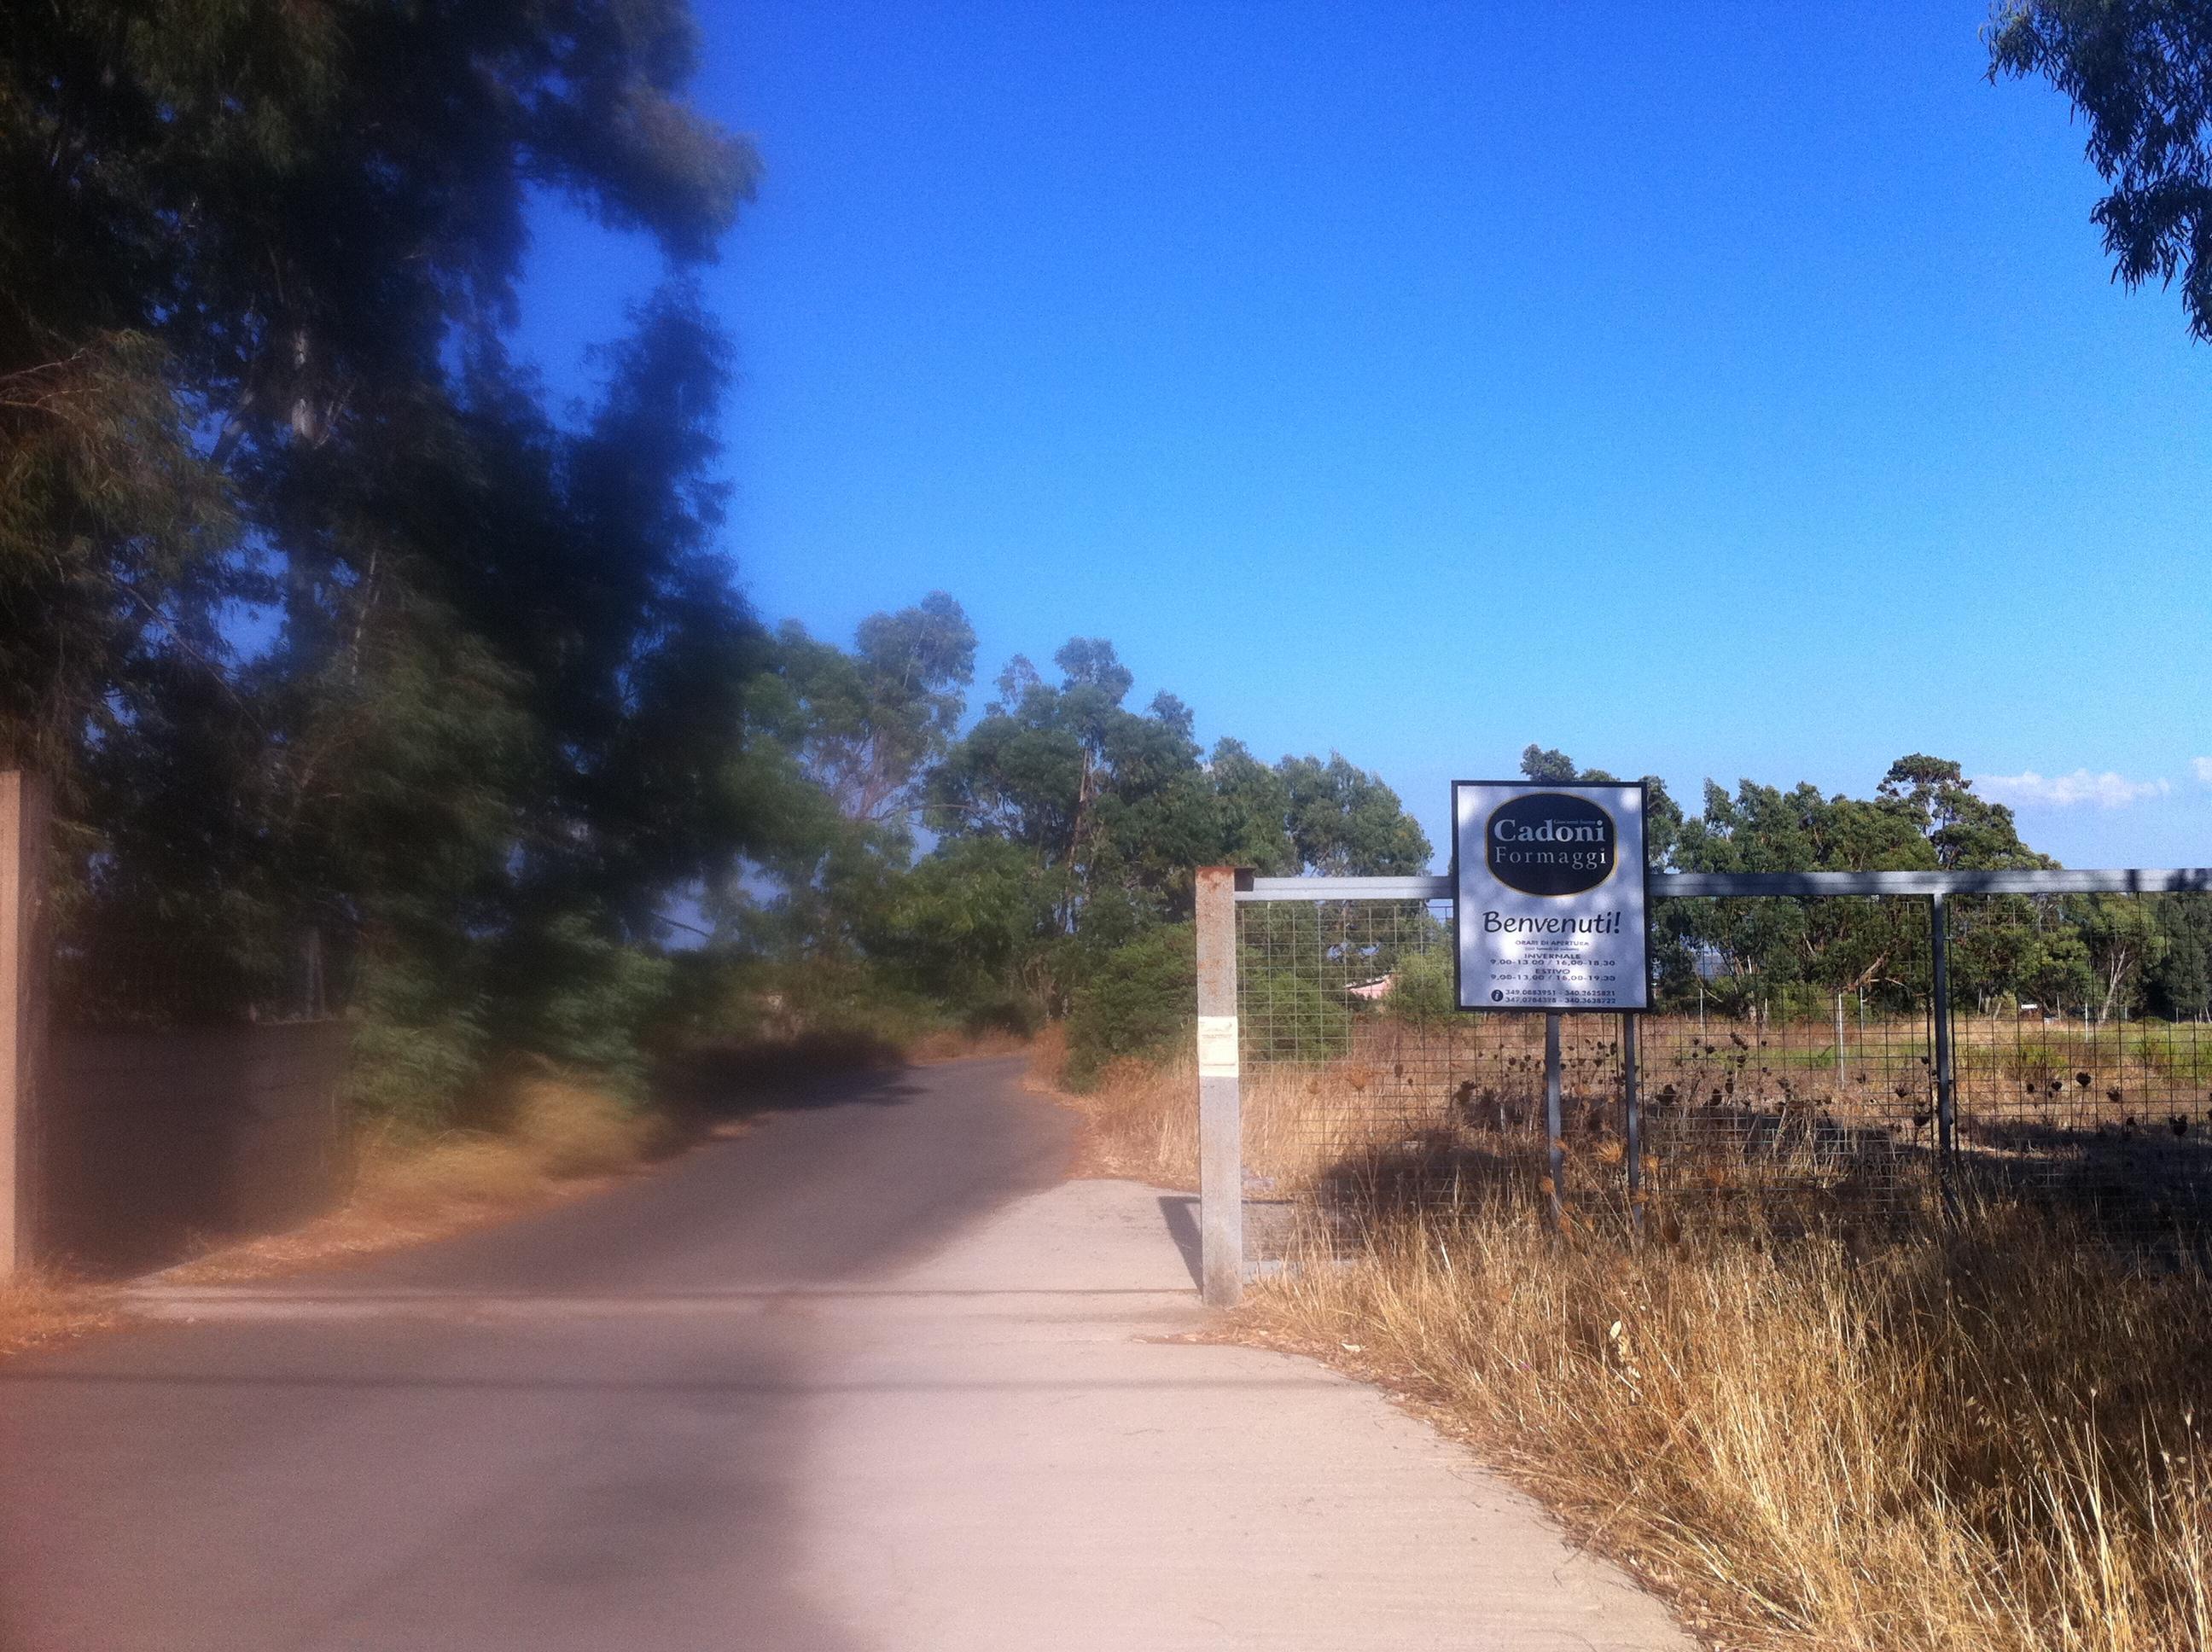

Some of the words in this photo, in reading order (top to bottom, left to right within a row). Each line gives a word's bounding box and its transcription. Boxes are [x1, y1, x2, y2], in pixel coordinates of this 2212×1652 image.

[1493, 819, 1606, 842] Cadoni
[1494, 846, 1606, 870] Formaggi
[1482, 910, 1621, 934] Benvenuti!
